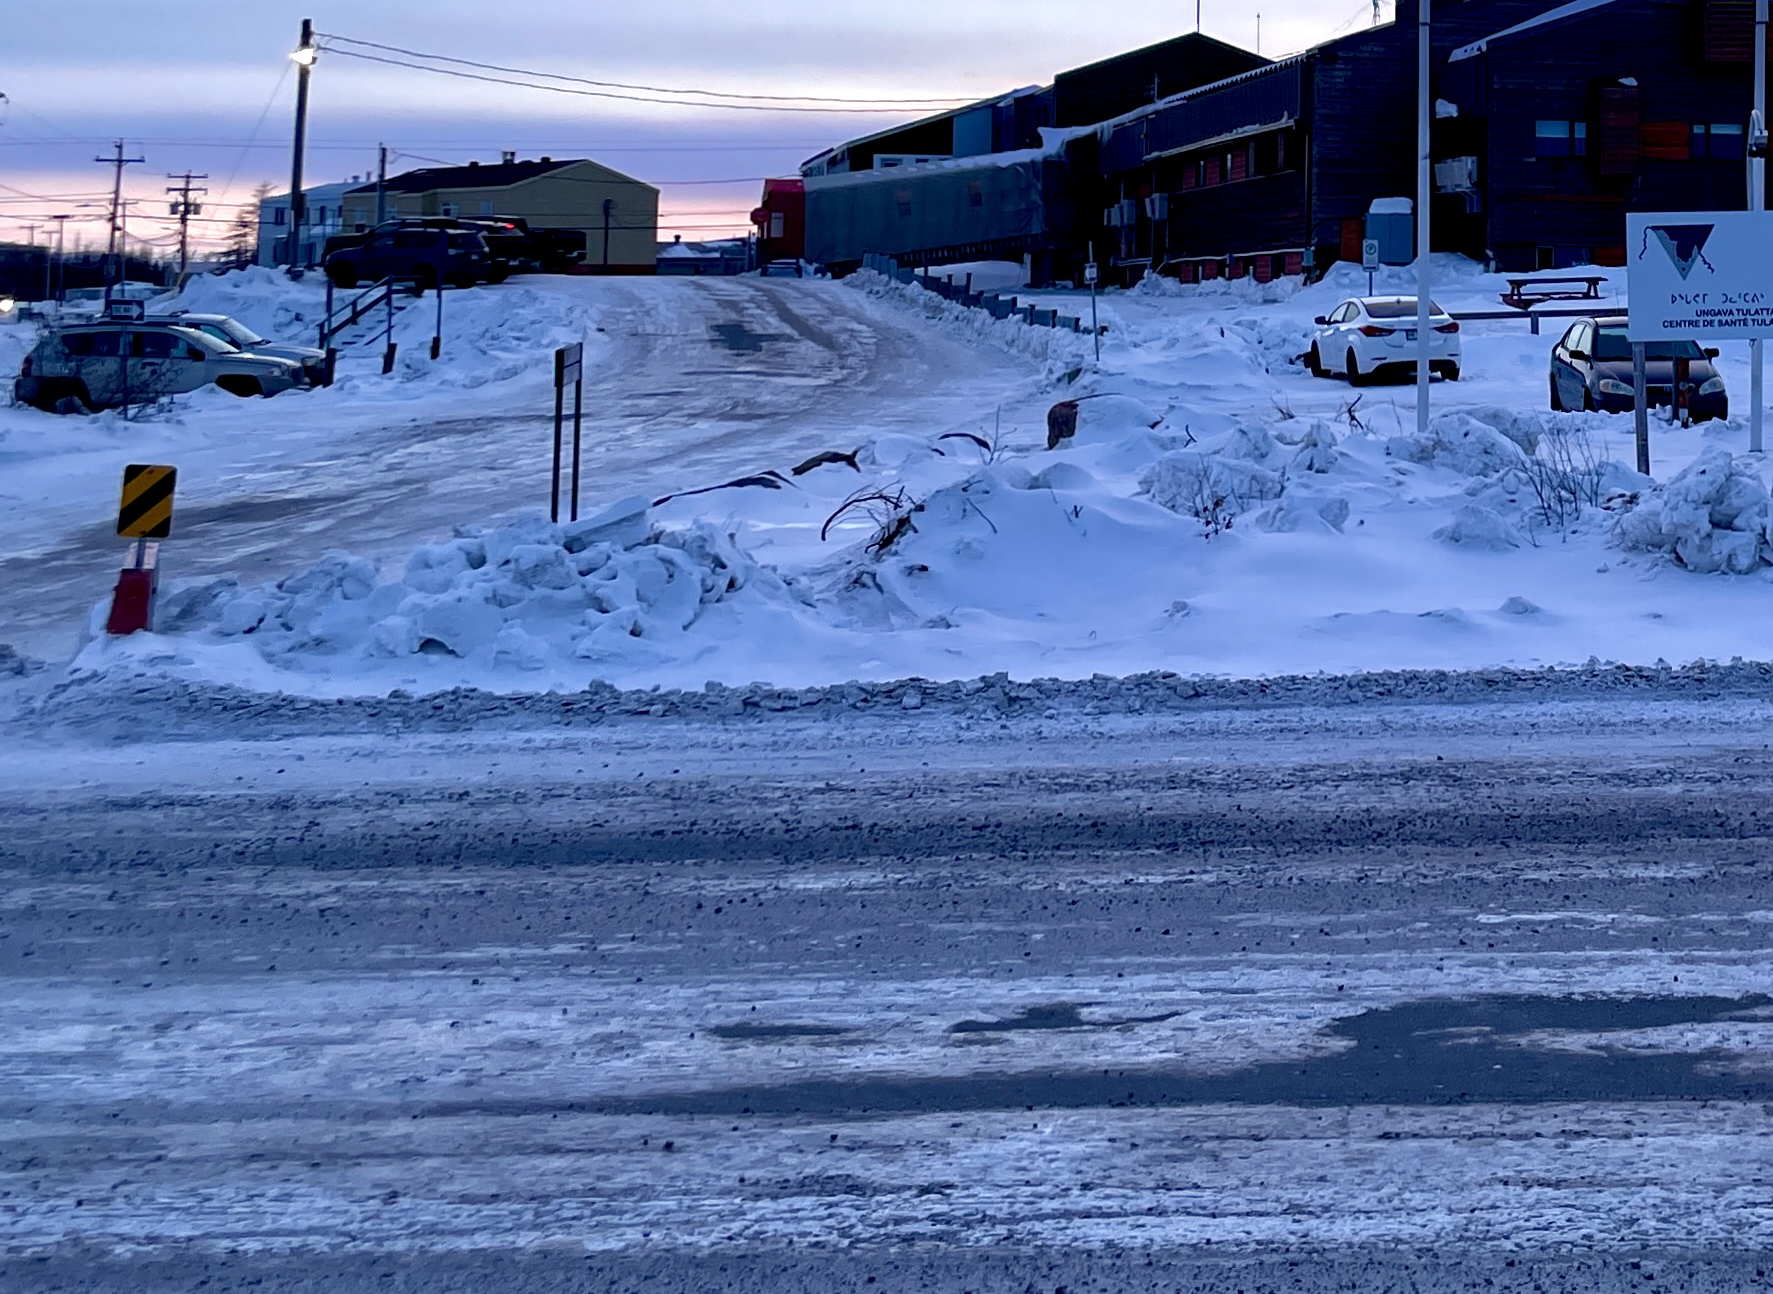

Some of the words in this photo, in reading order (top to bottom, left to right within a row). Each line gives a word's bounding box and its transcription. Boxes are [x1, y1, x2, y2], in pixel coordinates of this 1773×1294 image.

[1695, 308, 1734, 317] UNGAVA
[1662, 319, 1701, 328] CENTRE
[1702, 319, 1715, 328] DE
[1717, 318, 1749, 327] SANTÉ
